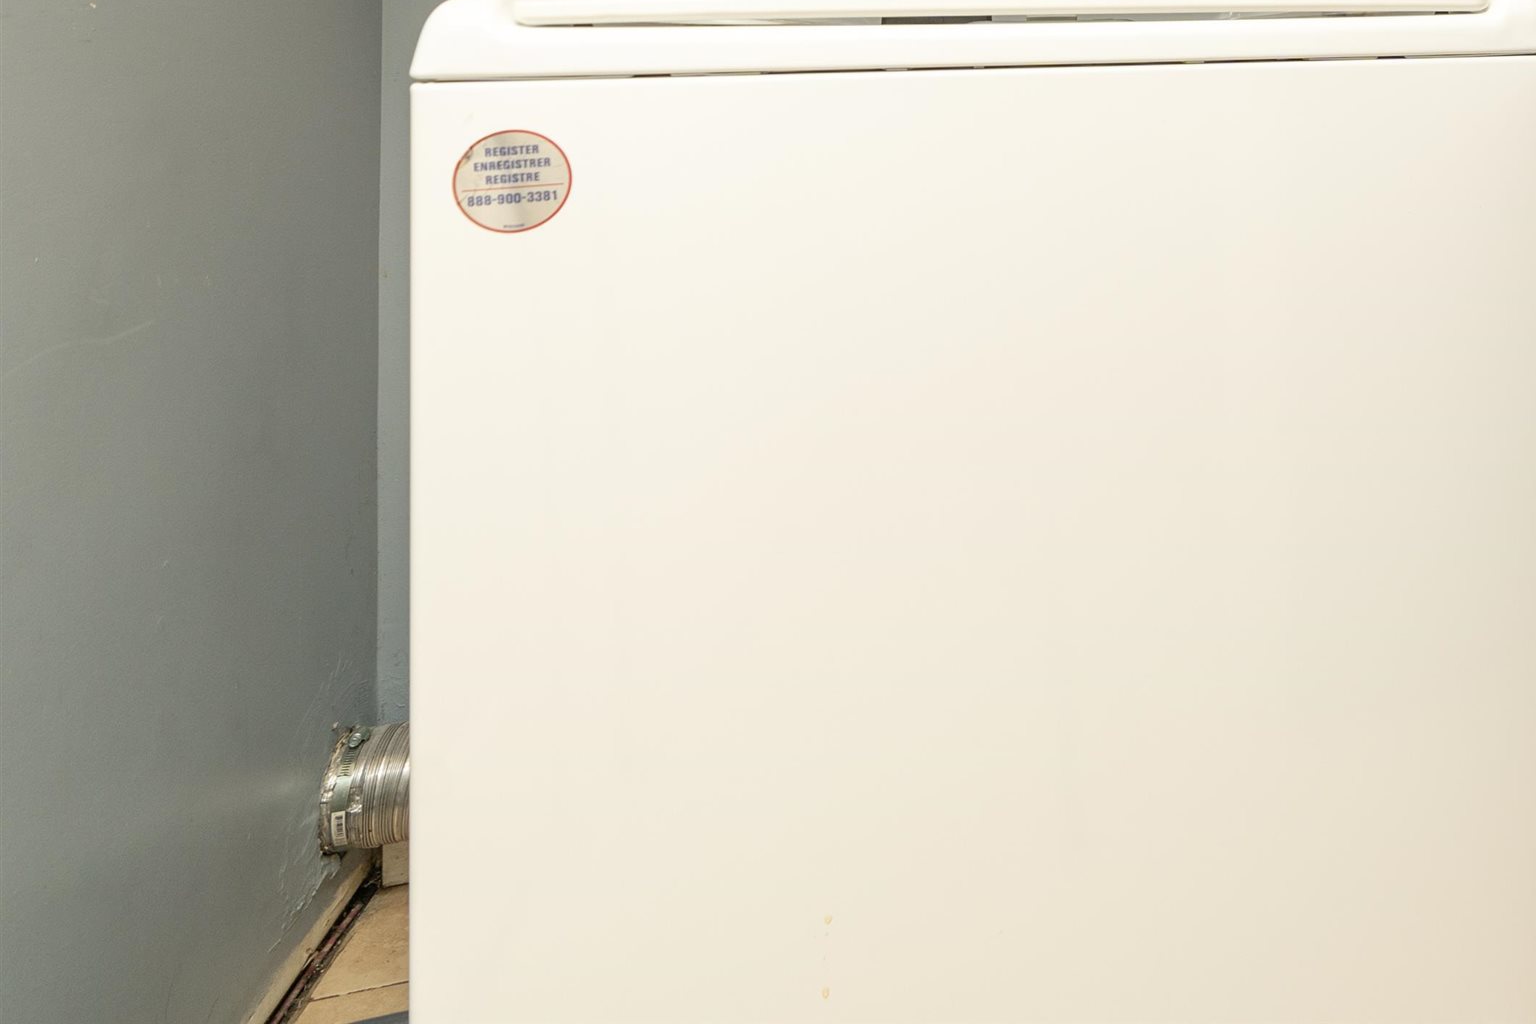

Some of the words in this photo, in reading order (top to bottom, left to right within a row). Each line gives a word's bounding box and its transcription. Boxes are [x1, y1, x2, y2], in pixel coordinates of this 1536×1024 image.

[485, 144, 540, 158] REGISTER
[474, 157, 551, 172] ENREGISTRER
[485, 172, 541, 185] REGISTRE
[467, 190, 558, 207] 888-900-3381
